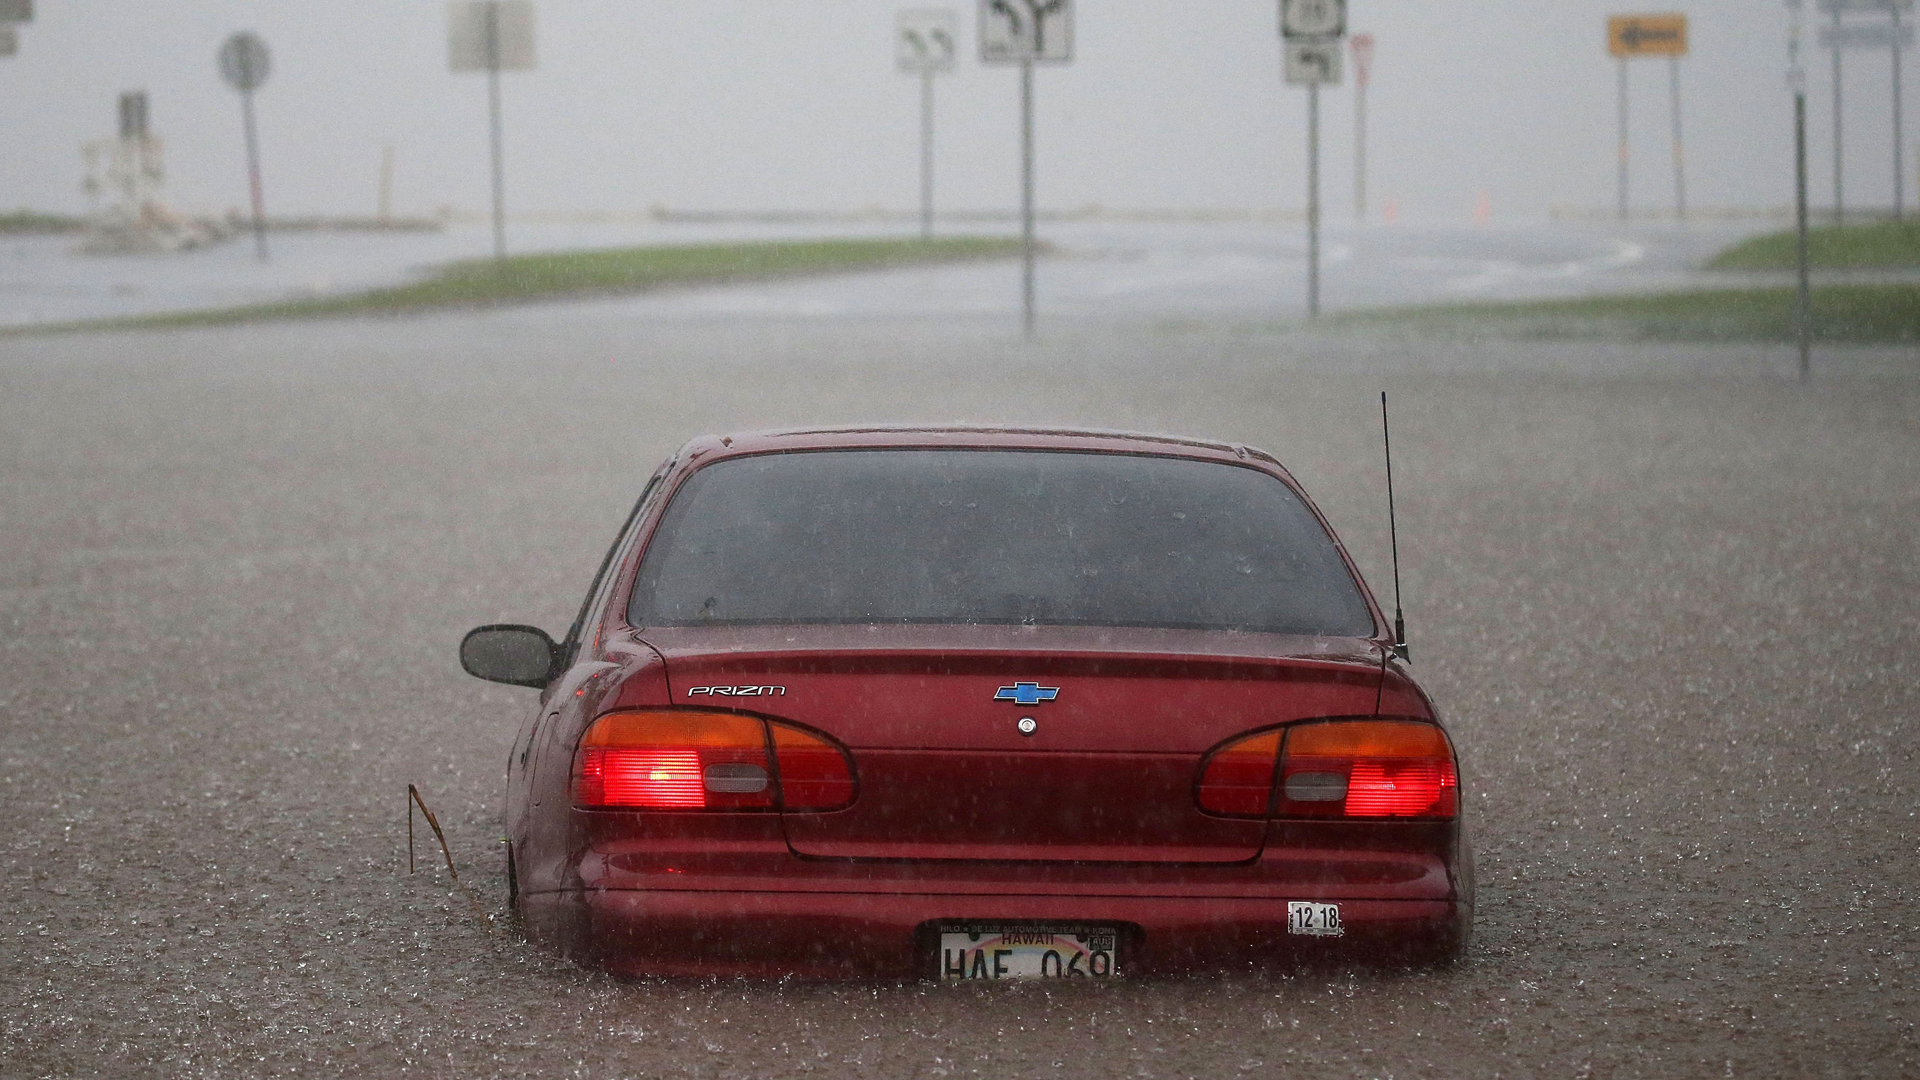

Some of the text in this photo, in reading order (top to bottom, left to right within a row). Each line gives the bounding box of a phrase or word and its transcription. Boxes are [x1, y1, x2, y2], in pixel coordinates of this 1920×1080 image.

[687, 685, 786, 697] PRIZM
[1295, 906, 1313, 928] 12
[1320, 907, 1338, 929] 18
[940, 925, 961, 933] HILO
[985, 925, 1000, 933] LUZ
[1002, 925, 1057, 934] AUTOMOTIVE
[1059, 926, 1082, 934] TEAM
[1092, 927, 1117, 935] KONA
[1002, 933, 1054, 945] HAWAII
[1092, 937, 1112, 946] AUG
